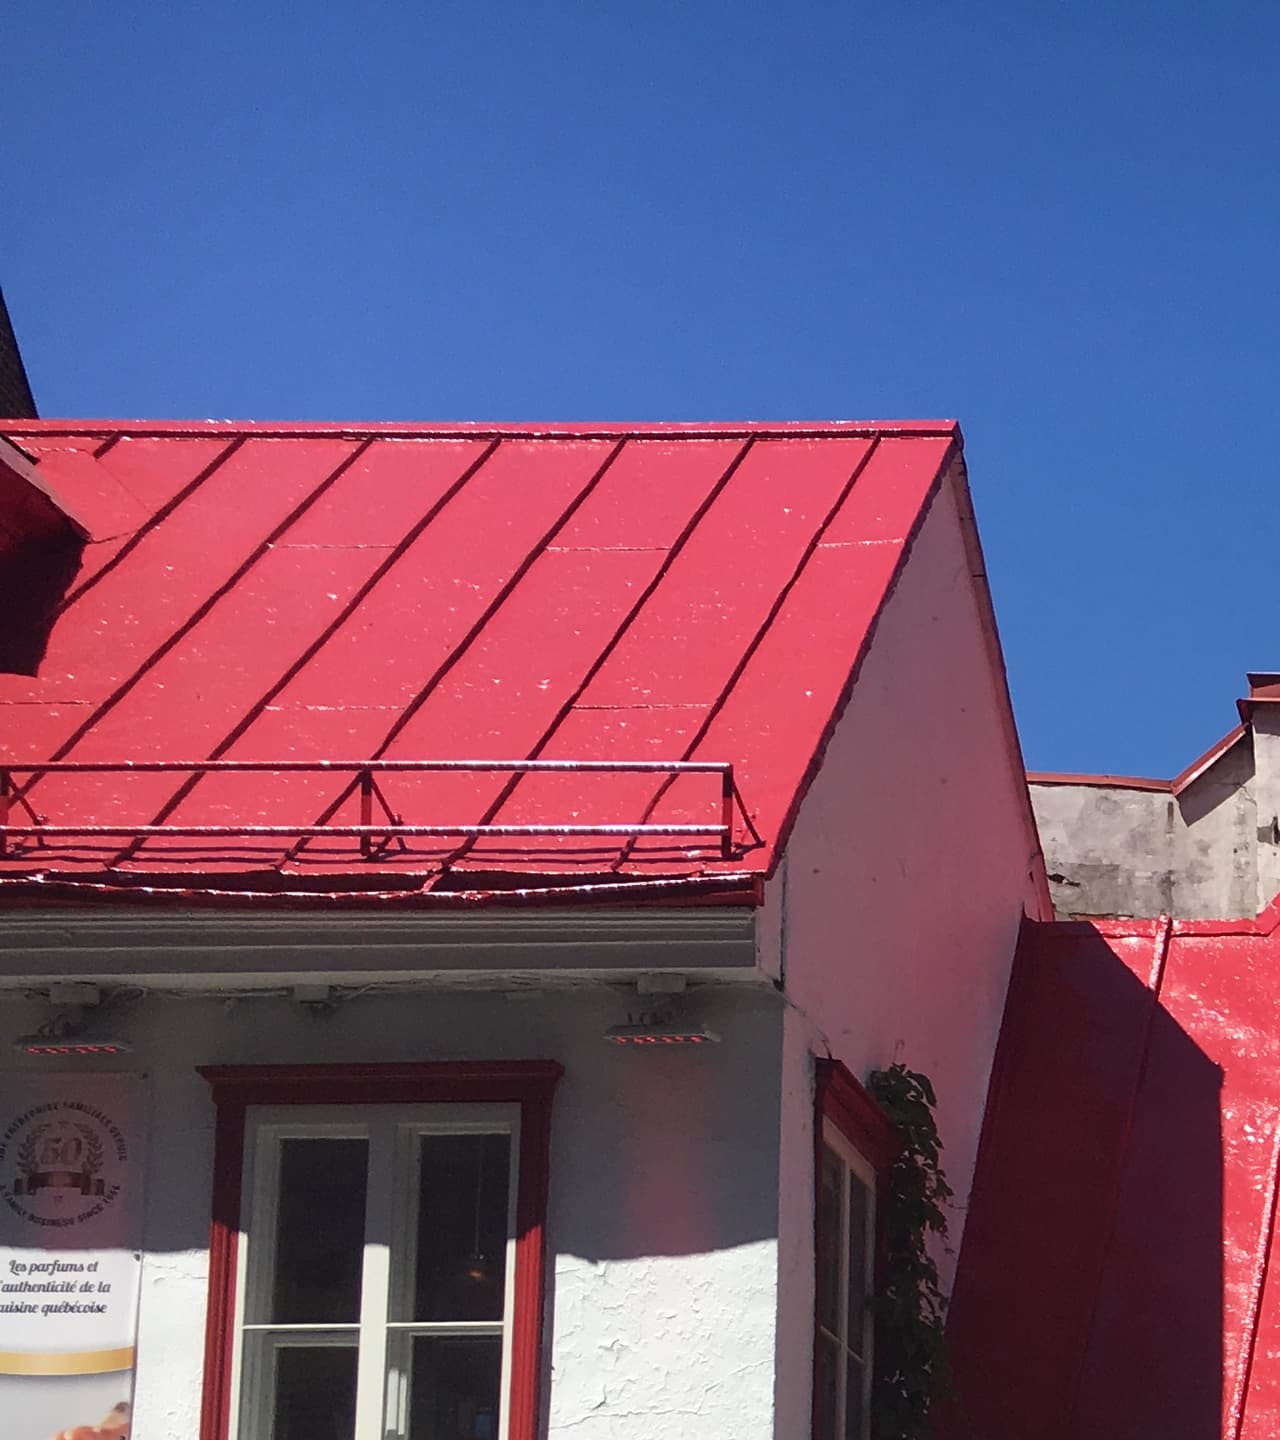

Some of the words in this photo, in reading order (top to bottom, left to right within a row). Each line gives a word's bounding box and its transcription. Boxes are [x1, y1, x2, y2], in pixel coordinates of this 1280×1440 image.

[40, 1136, 82, 1165] 50
[9, 1259, 28, 1276] Les
[27, 1259, 85, 1276] parfums
[86, 1260, 99, 1273] et
[79, 1280, 96, 1293] de
[97, 1281, 112, 1293] la
[0, 1301, 40, 1314] uisine
[41, 1300, 108, 1317] québécoise
